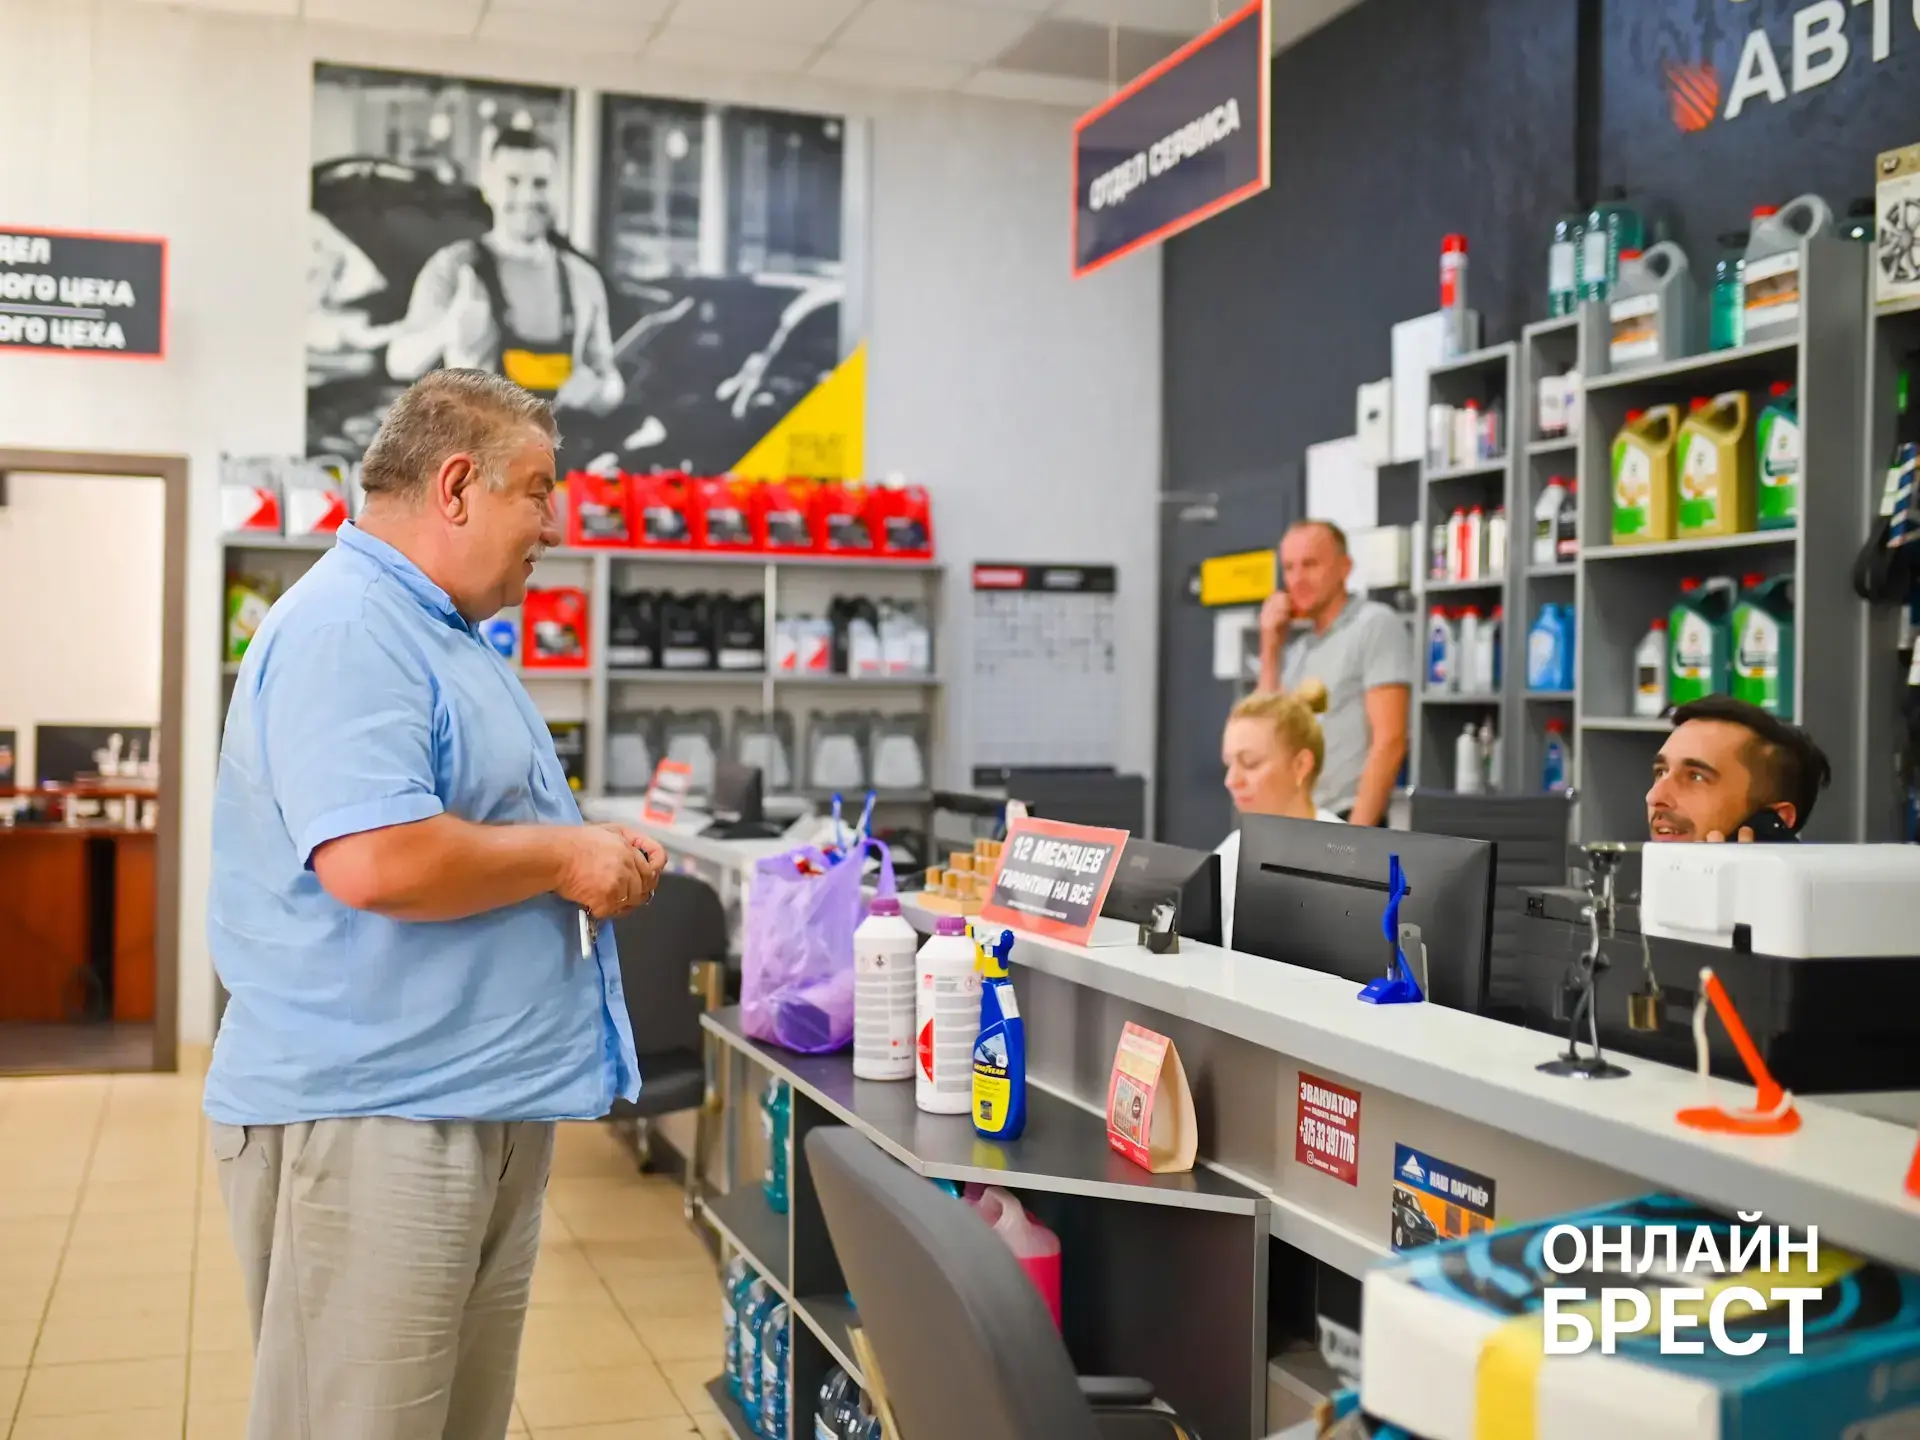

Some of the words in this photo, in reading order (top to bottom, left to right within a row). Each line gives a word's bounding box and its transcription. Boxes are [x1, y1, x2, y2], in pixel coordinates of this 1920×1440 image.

[1723, 0, 1920, 120] АВТ
[1089, 150, 1148, 213] ОТДЕЛ
[1149, 97, 1241, 177] СЕРВИСА
[0, 271, 58, 302] ОГО
[58, 275, 136, 308] ЦЕХА
[50, 316, 126, 349] ЦЕХА
[1013, 835, 1035, 861] 12
[997, 868, 1056, 897] ГАРАНТИИ
[1051, 880, 1072, 901] НА
[1067, 881, 1094, 906] ВСЁ
[973, 1061, 1007, 1076] GOODYEAR
[1300, 1081, 1358, 1120] ЭВАКУАТОР
[1299, 1116, 1316, 1148] +375
[1316, 1121, 1326, 1153] 33
[1429, 1170, 1449, 1193] НАШ
[1450, 1178, 1489, 1208] ПАРТНЁР
